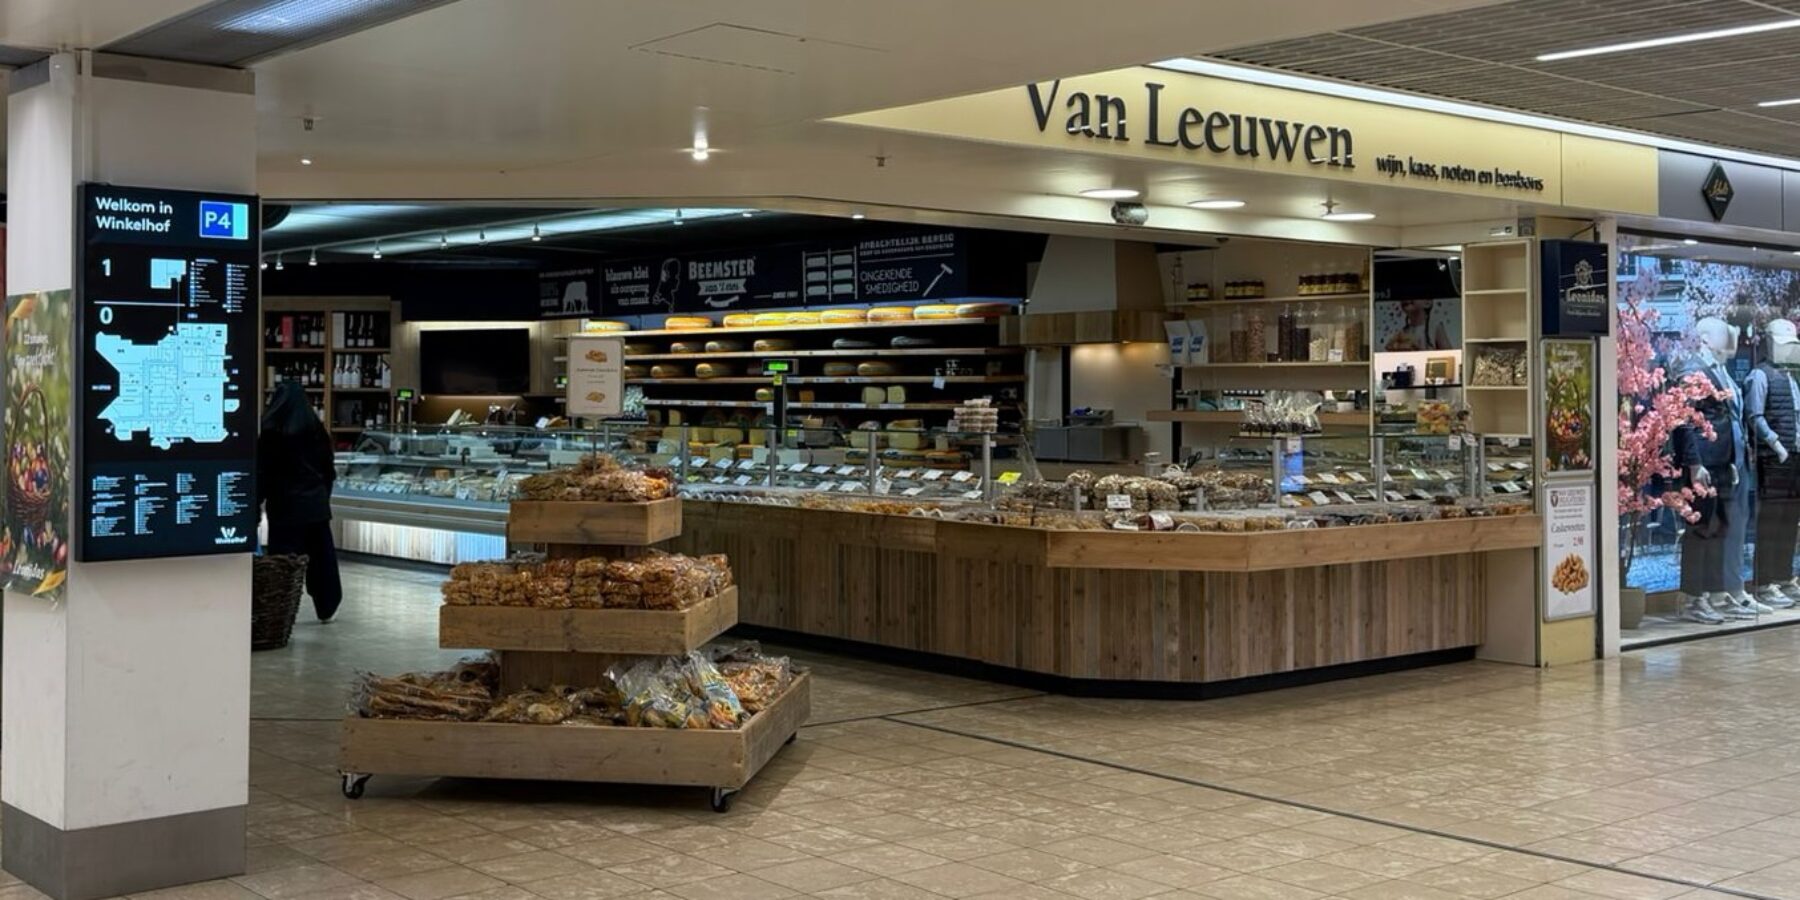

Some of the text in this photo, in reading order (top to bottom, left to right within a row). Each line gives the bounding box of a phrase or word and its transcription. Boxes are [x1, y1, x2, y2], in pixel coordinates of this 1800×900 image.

[1026, 79, 1355, 169] Van Leeuwen
[1376, 155, 1544, 192] wijn, kaas, noten en bonbons
[95, 196, 173, 215] Welkom in
[95, 215, 171, 233] Winkelhof
[204, 211, 232, 230] P4
[101, 258, 112, 277] 1
[688, 258, 756, 280] BEEMSTER
[99, 306, 114, 325] 0
